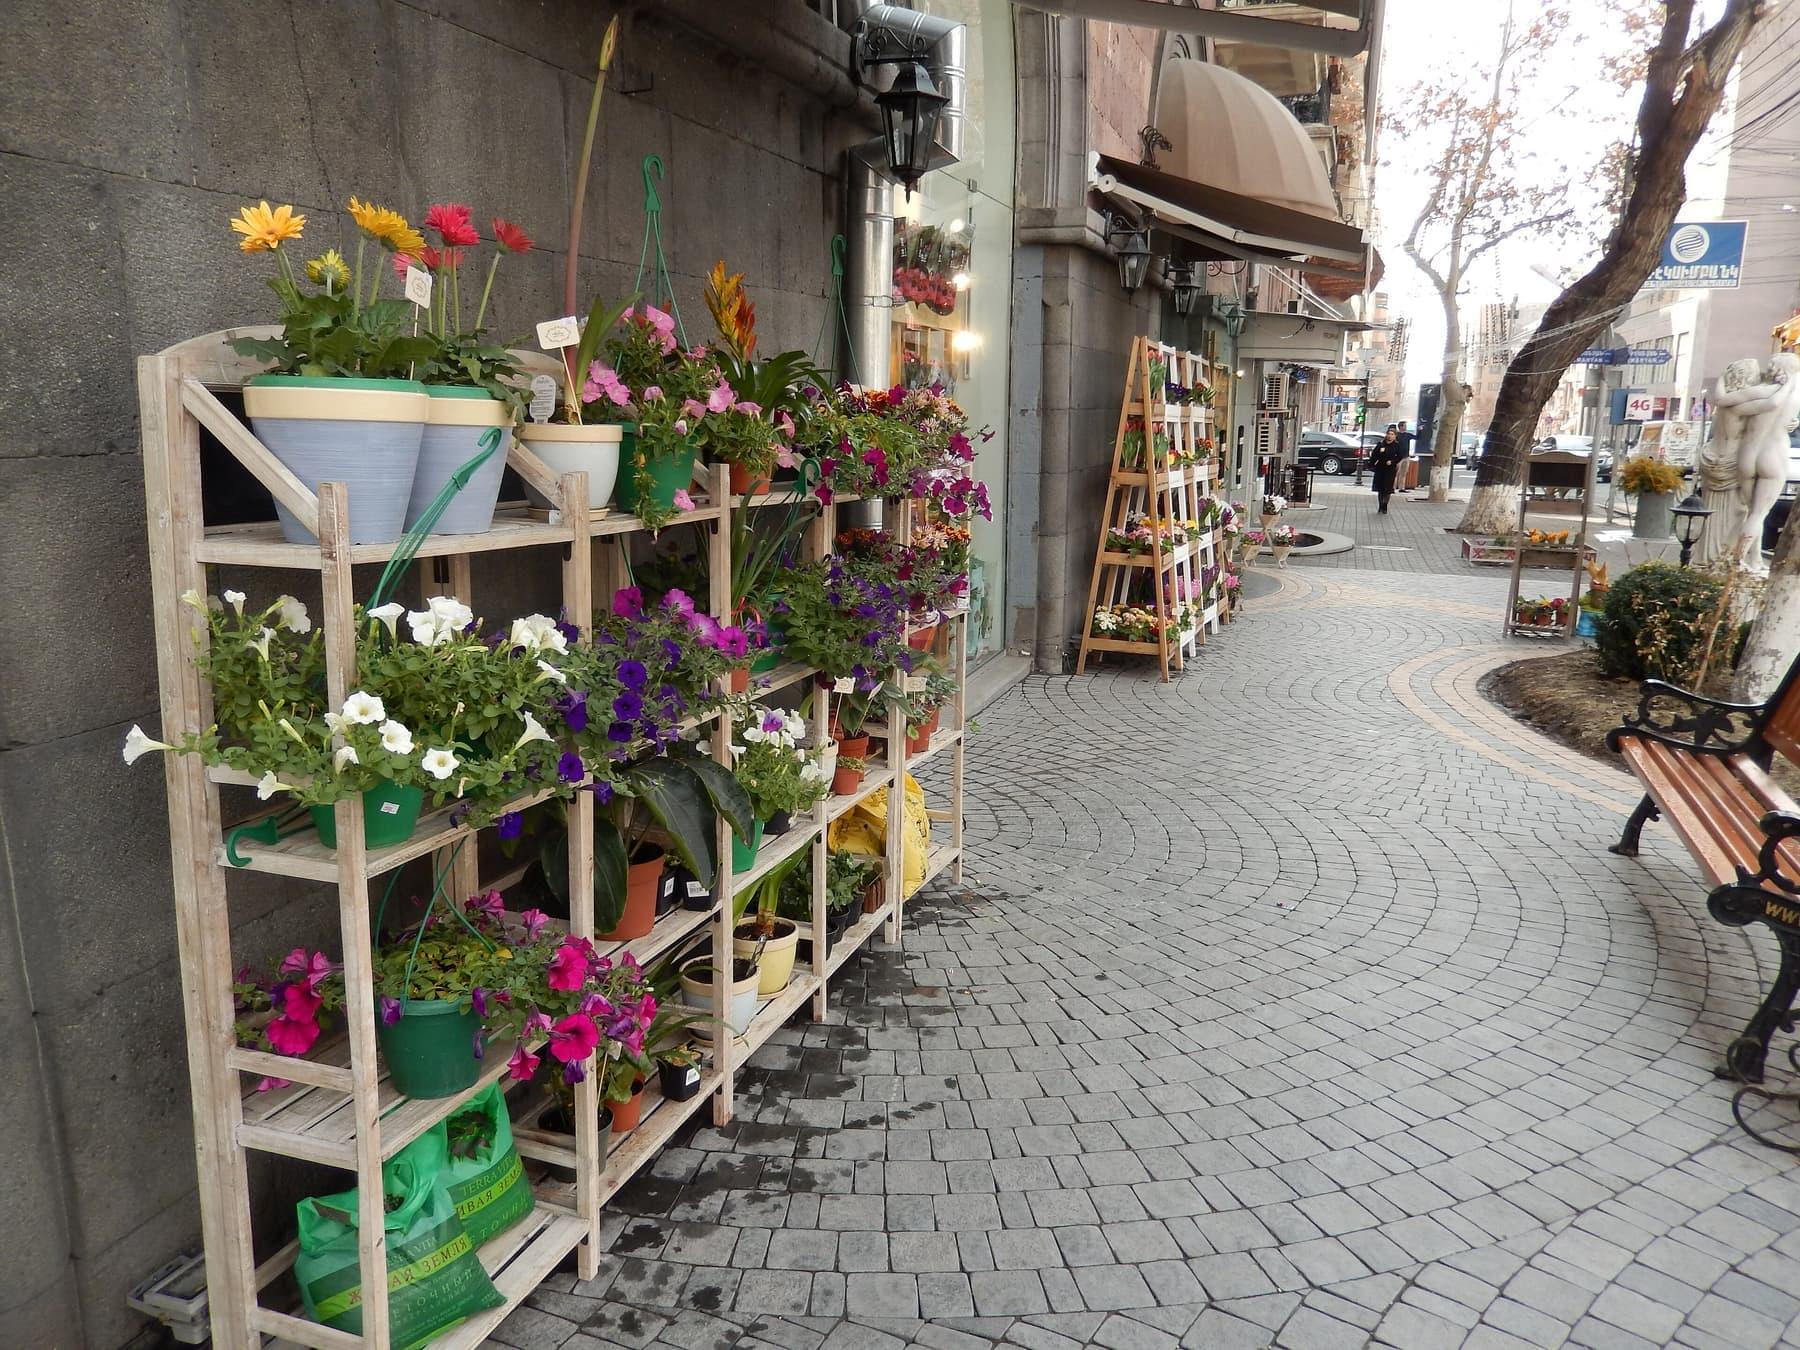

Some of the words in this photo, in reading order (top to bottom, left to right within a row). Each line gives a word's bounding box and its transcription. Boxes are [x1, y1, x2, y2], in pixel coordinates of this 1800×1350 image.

[1648, 265, 1738, 280] ԷԿՍԻՄԲԱՆԿ
[1630, 399, 1650, 411] 4G
[455, 1190, 493, 1217] ИВАЯ
[422, 1237, 468, 1274] ЗЕМЛЯ
